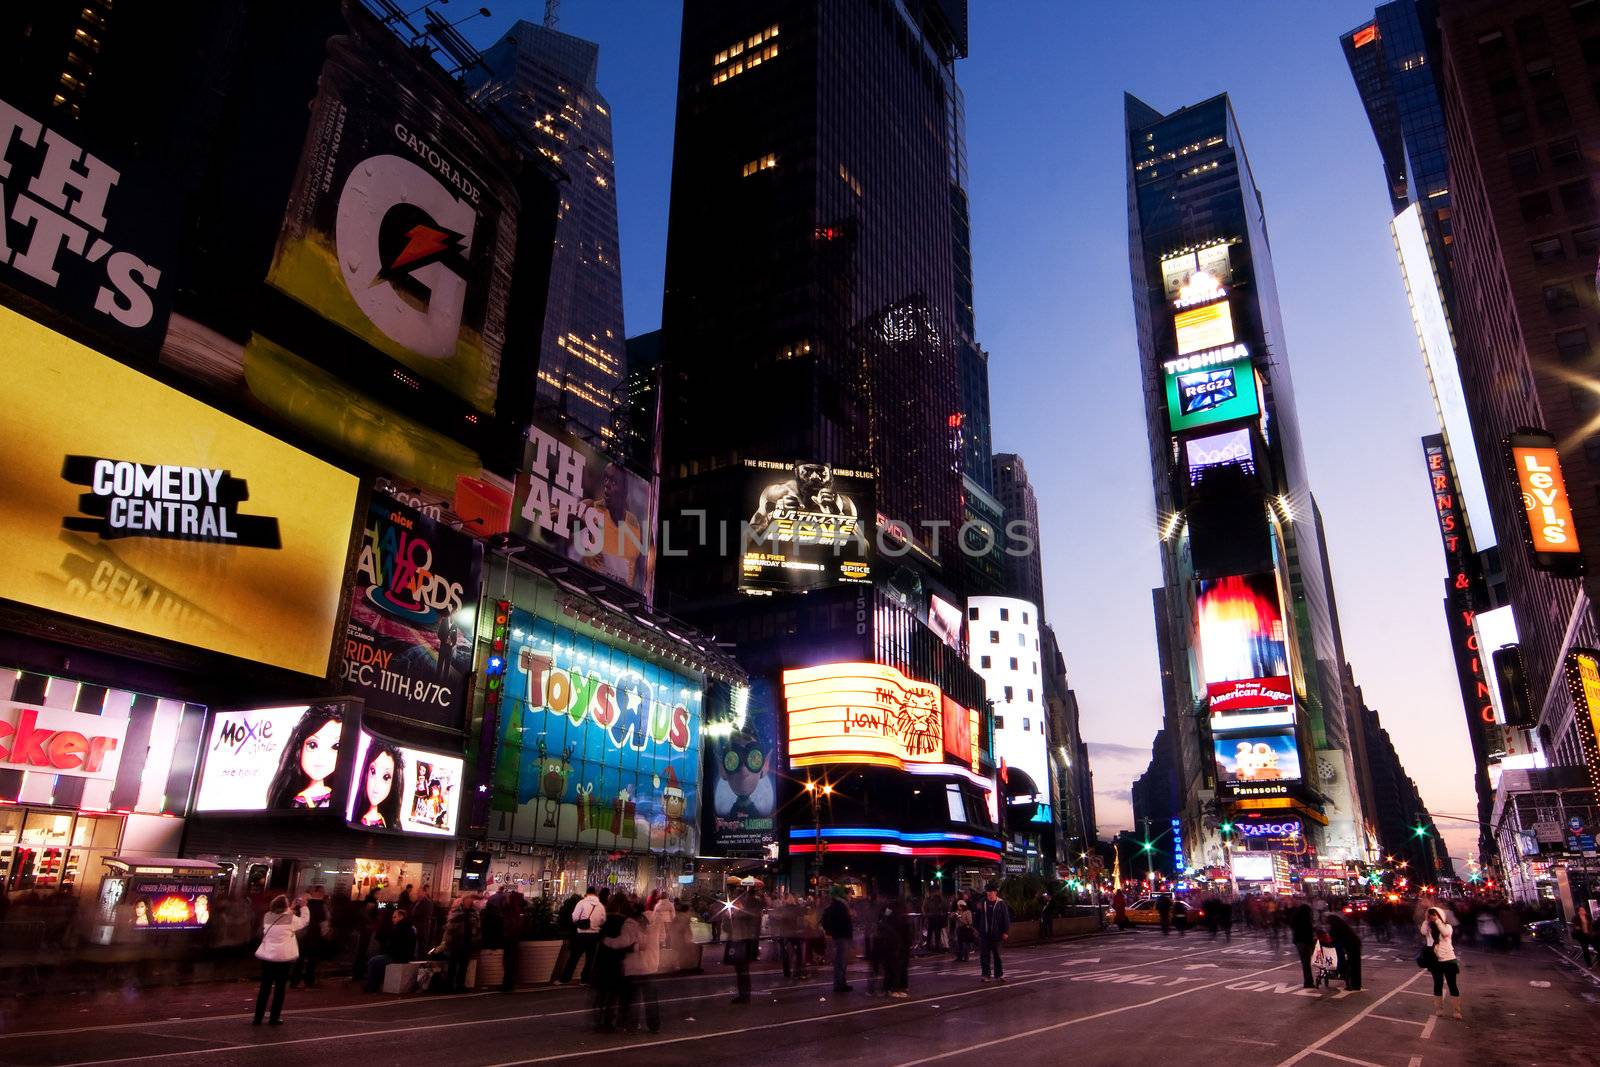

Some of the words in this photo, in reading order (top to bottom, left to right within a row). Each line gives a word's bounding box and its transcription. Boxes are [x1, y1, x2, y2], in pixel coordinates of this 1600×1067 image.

[394, 123, 481, 205] GATORADE
[336, 154, 478, 360] G
[1164, 344, 1249, 374] TOSHIBA
[1185, 379, 1232, 397] REGZA
[529, 425, 586, 498] TH
[743, 460, 757, 468] THE
[758, 461, 784, 470] RETURN
[785, 463, 795, 471] OF
[833, 468, 854, 477] KIMBO
[855, 471, 874, 480] SLICE
[92, 459, 224, 503] COMEDY
[110, 497, 238, 539] CENTRAL
[771, 508, 858, 528] ULTIMATE
[1430, 454, 1458, 552] ERNST
[1455, 574, 1469, 589] &
[767, 554, 786, 562] FREE
[840, 566, 871, 574] SPIKE
[344, 640, 392, 670] RIDAY
[519, 648, 616, 727] TOYS
[650, 702, 692, 752] US
[875, 687, 894, 705] THE
[1210, 688, 1258, 706] American
[1259, 687, 1292, 701] Lager
[843, 707, 880, 734] LION
[1233, 785, 1288, 795] Panasonic
[1235, 821, 1300, 836] YAHOO!
[1070, 973, 1206, 985] ONLY
